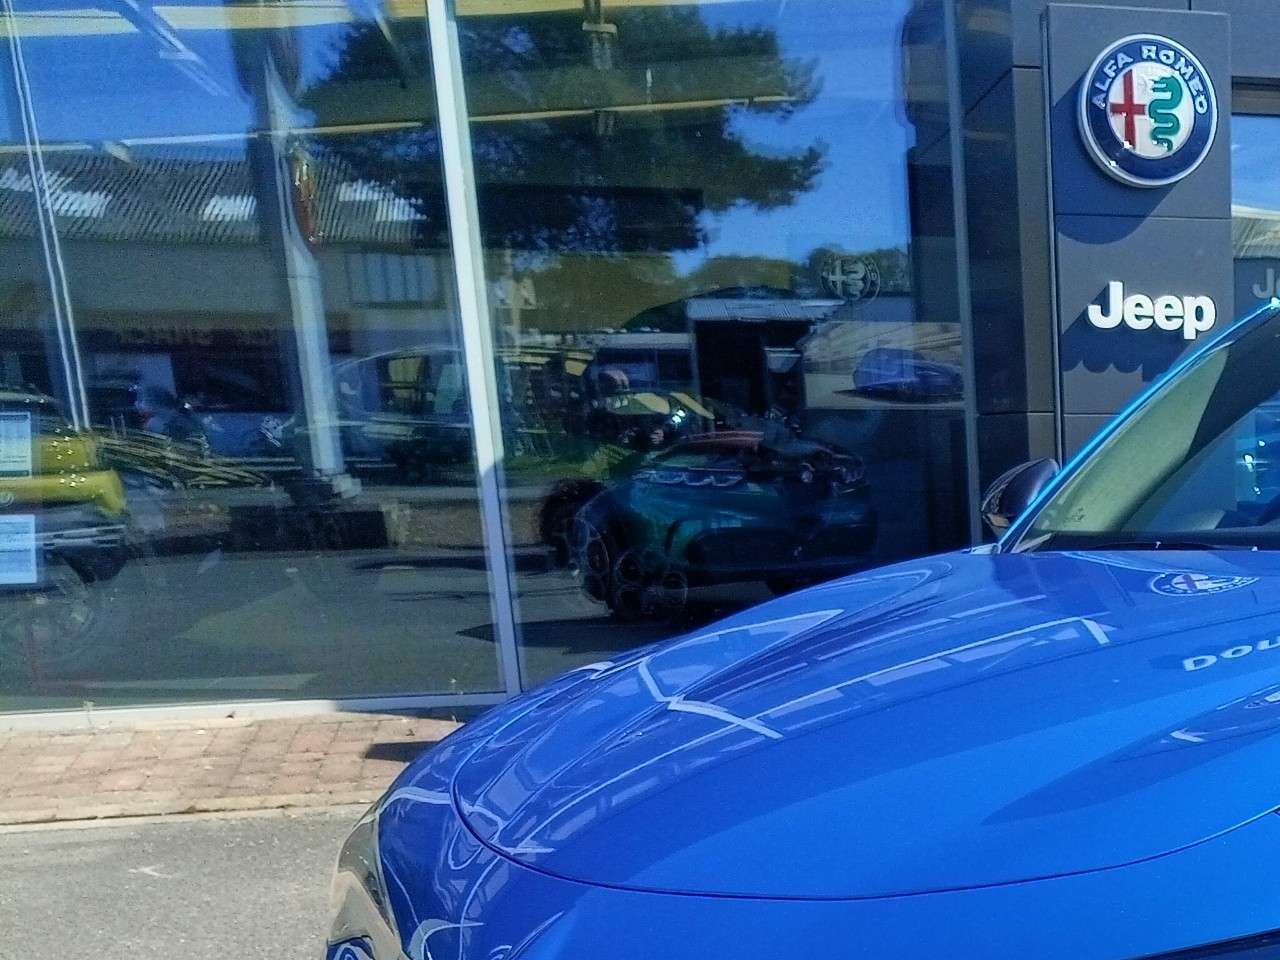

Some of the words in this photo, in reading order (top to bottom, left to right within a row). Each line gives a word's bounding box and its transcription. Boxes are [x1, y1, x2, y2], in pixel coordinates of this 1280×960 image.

[1092, 52, 1134, 110] ALFA
[1141, 45, 1208, 114] ROMEO
[1087, 280, 1216, 340] Jeep
